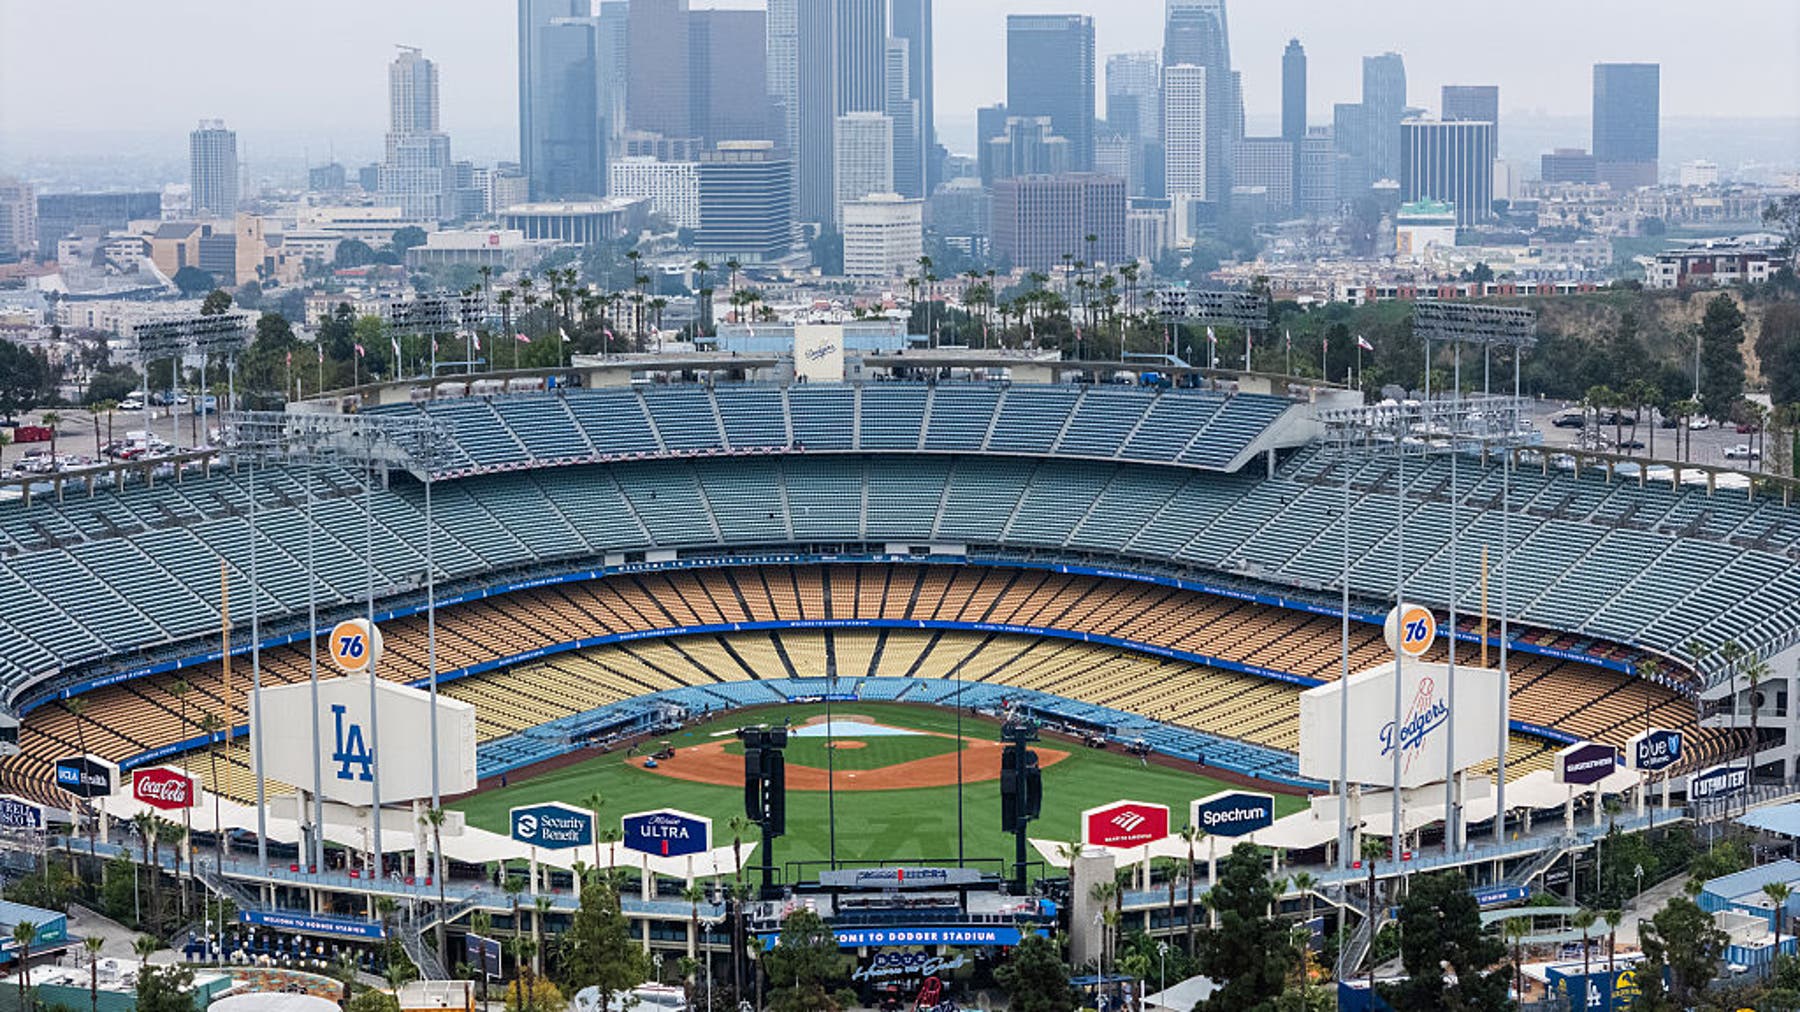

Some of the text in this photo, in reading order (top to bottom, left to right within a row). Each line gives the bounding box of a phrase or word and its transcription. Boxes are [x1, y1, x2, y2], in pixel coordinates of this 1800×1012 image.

[1405, 619, 1427, 642] 76
[340, 635, 364, 658] 76
[1380, 699, 1449, 756] Dodgers
[331, 704, 374, 782] LA
[58, 769, 78, 782] UCLA
[541, 815, 586, 831] Security
[1203, 807, 1265, 827] Spectrum
[542, 828, 580, 842] Benefit
[640, 824, 690, 839] ULTRA
[869, 932, 883, 942] TO
[889, 932, 938, 942] DODGER
[942, 931, 996, 942] STADIUM
